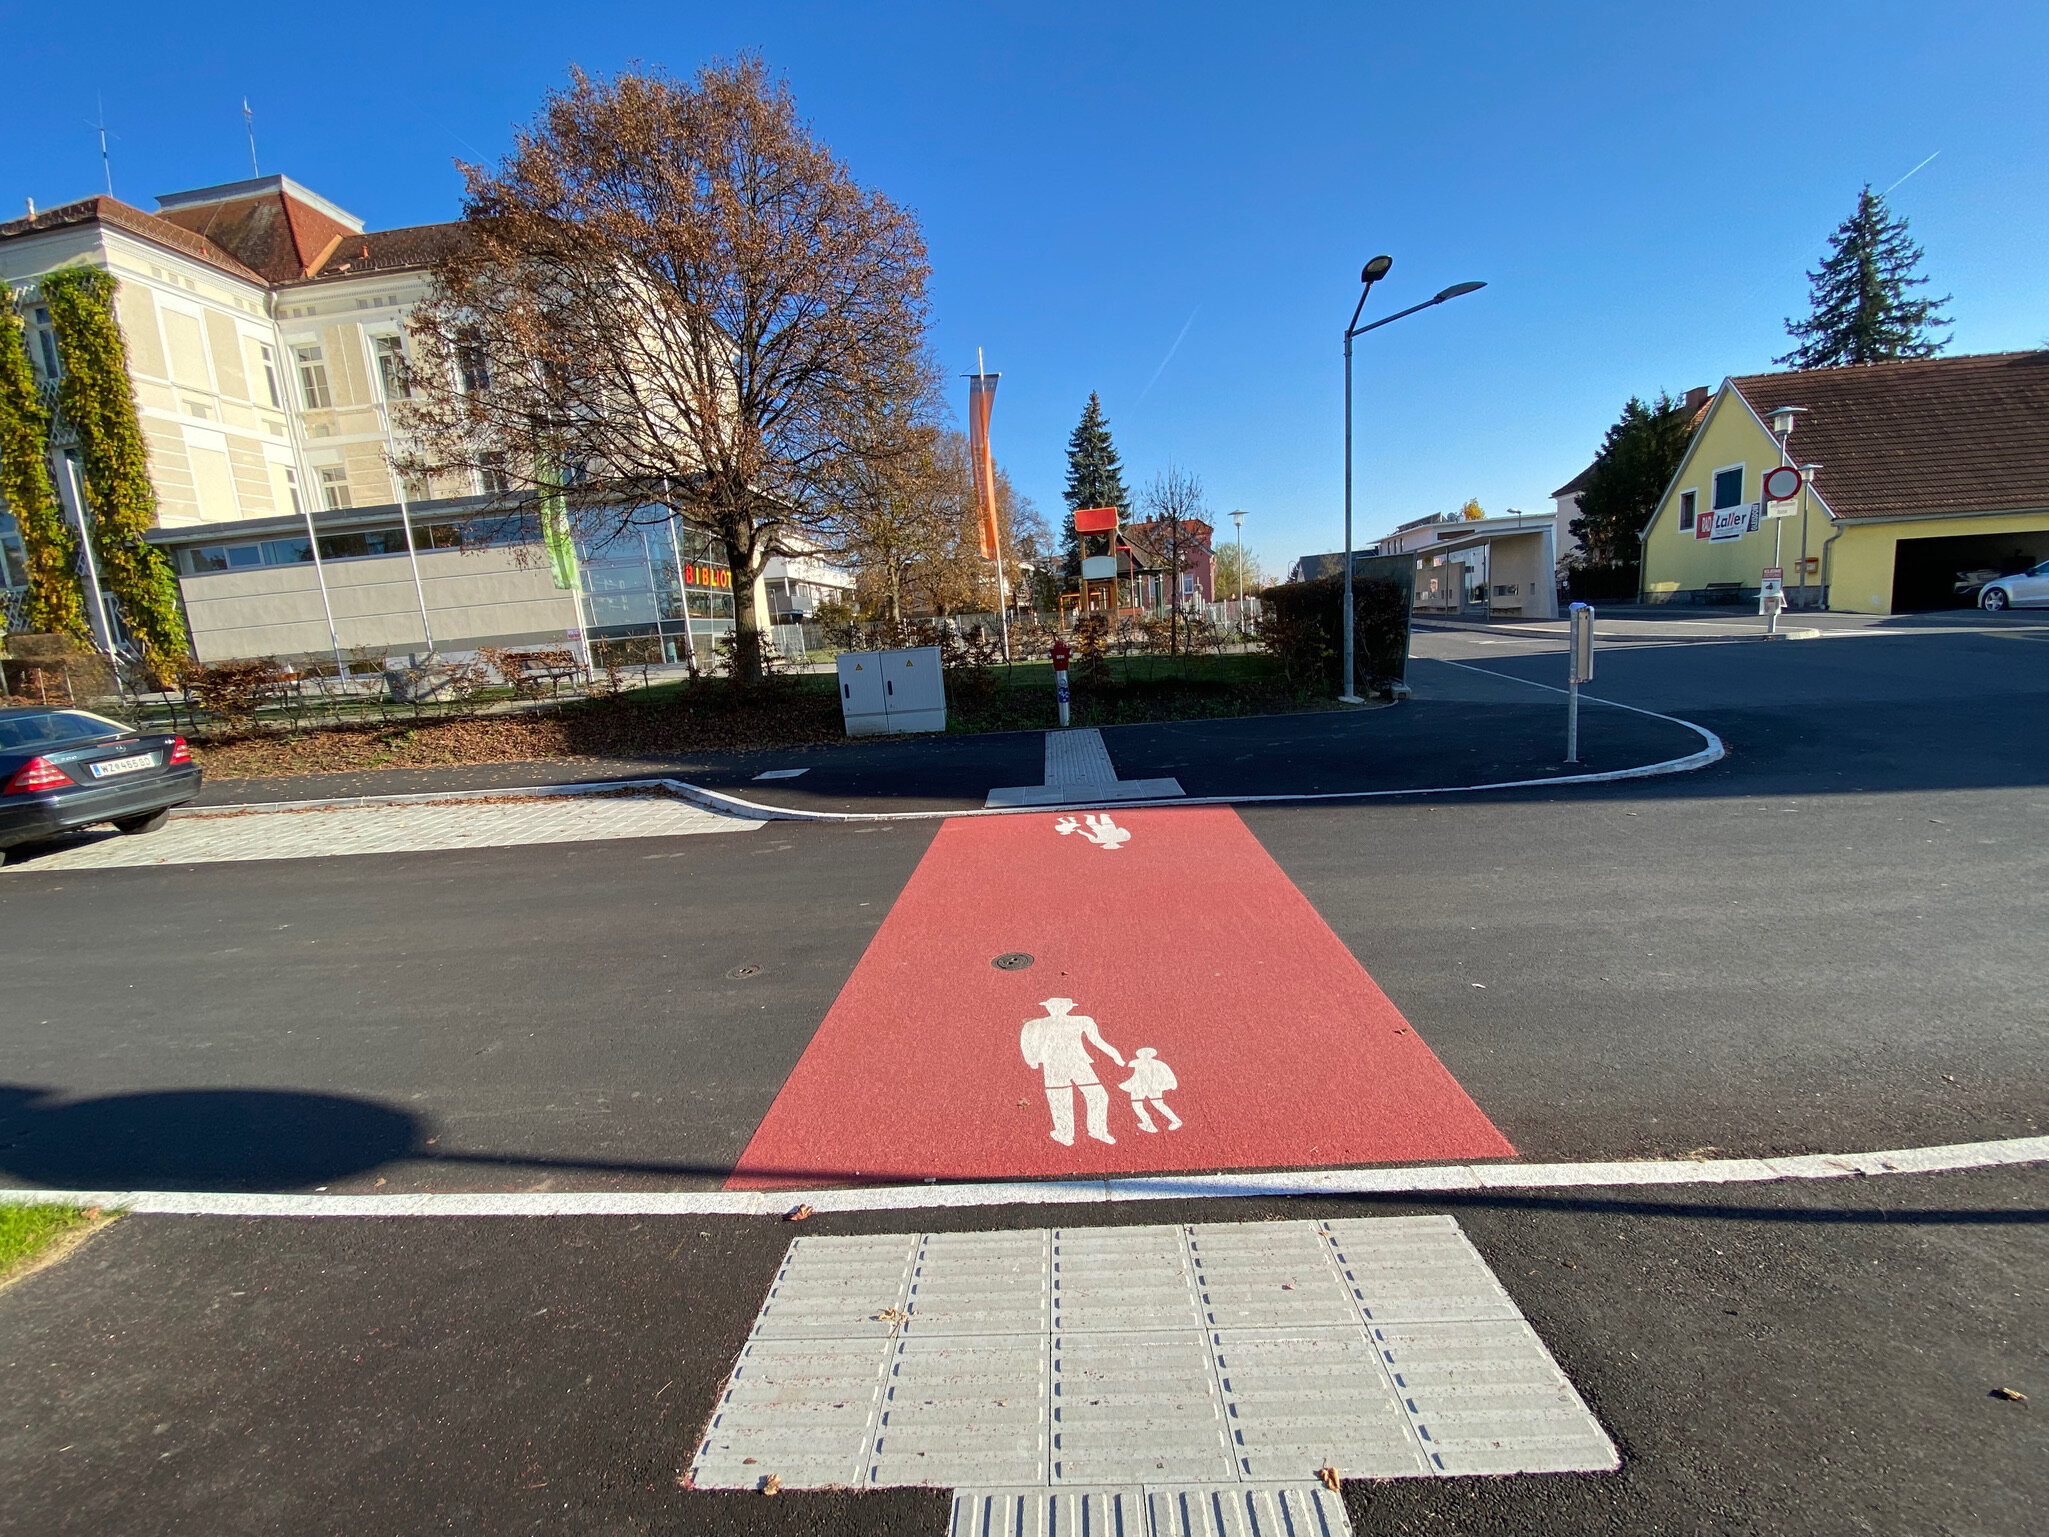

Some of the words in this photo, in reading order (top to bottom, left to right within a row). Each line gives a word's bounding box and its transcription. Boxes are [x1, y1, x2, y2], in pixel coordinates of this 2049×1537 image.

[1716, 513, 1747, 528] Laller
[685, 564, 732, 588] BIBLIOT
[101, 764, 115, 773] WZ
